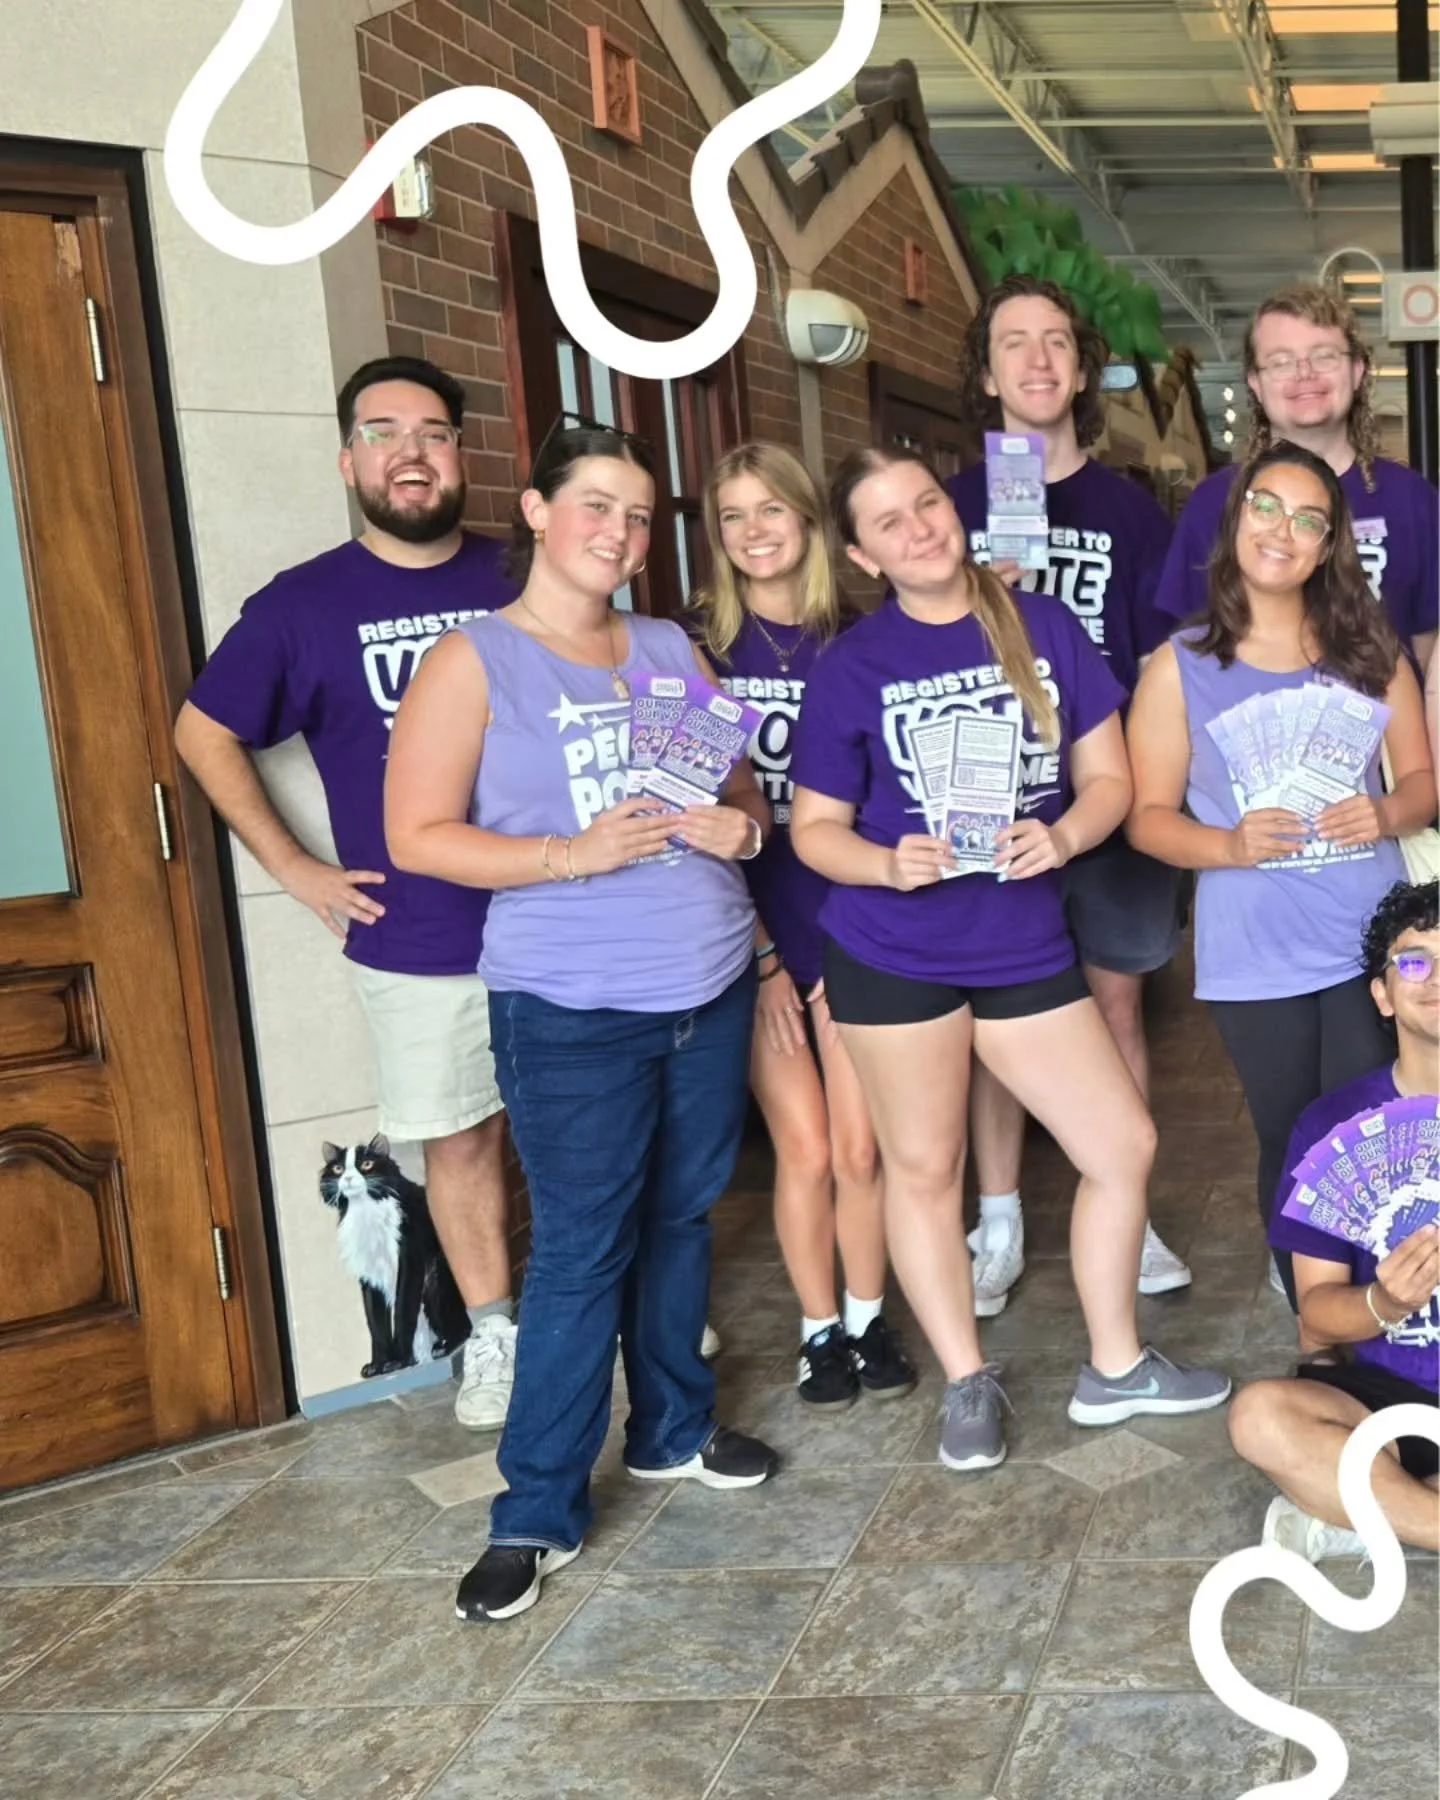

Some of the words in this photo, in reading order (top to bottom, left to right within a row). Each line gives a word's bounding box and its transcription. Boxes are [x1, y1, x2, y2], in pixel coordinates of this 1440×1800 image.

[1082, 531, 1112, 552] TO
[1079, 619, 1105, 644] E
[665, 701, 684, 711] VO
[663, 711, 680, 720] VO
